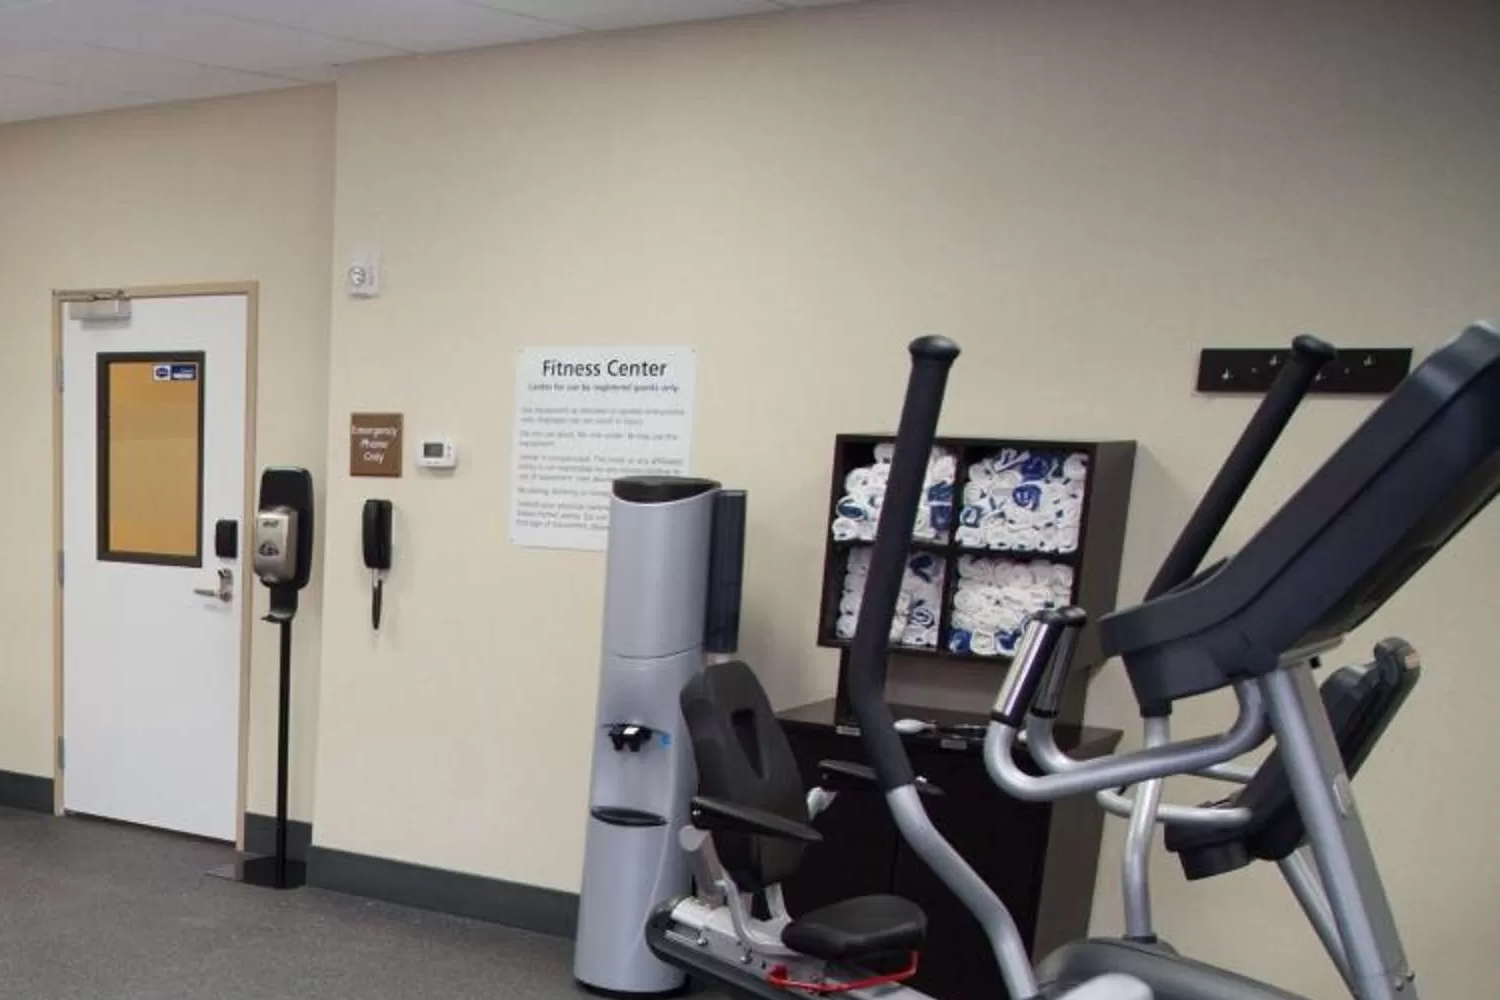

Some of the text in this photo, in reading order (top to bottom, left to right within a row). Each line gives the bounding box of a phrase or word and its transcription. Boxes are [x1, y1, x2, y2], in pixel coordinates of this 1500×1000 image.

[542, 359, 667, 377] Fitness Center
[352, 425, 398, 439] Emergency
[363, 451, 385, 464] Only
